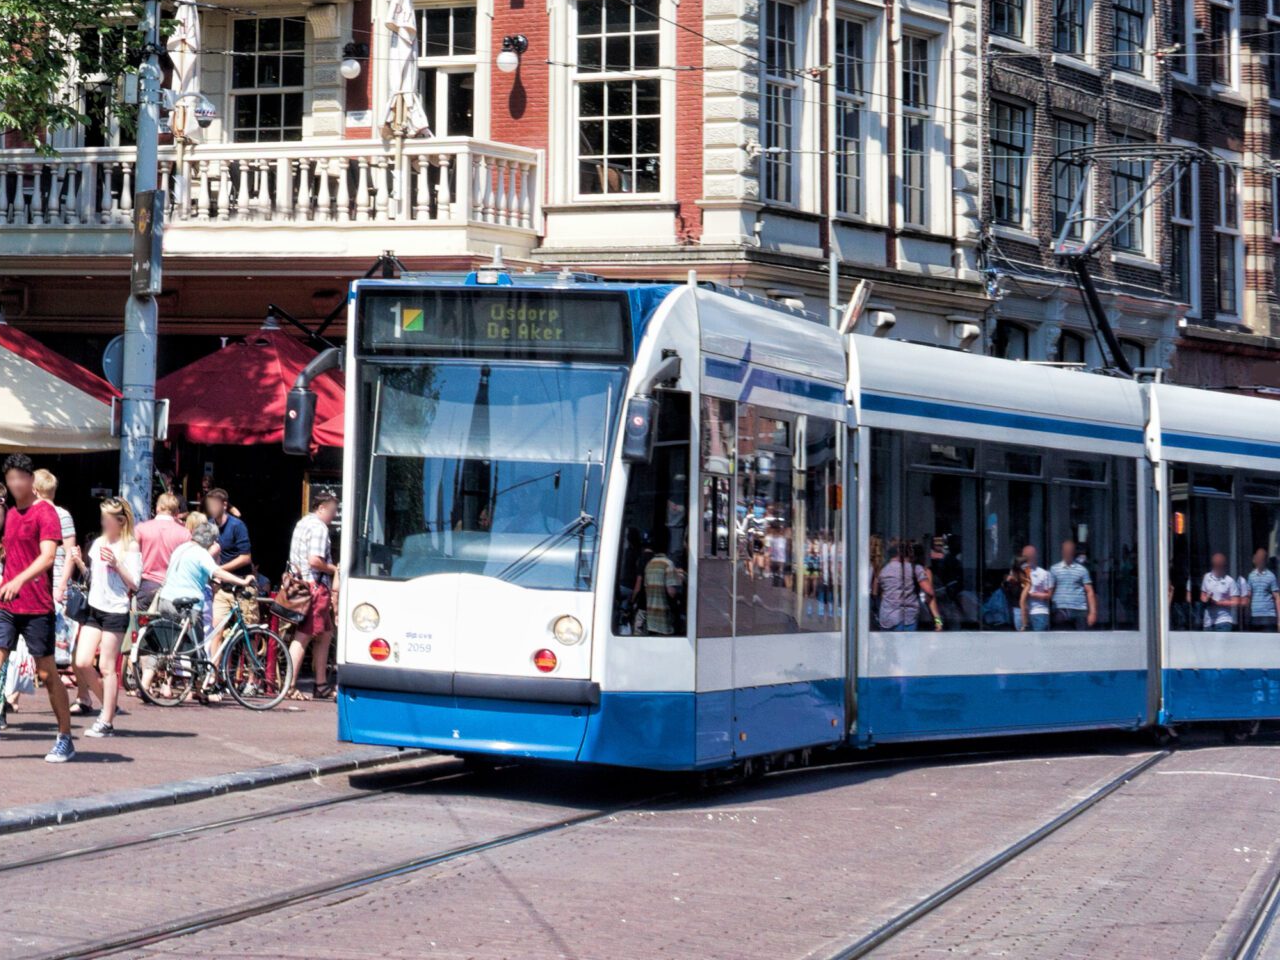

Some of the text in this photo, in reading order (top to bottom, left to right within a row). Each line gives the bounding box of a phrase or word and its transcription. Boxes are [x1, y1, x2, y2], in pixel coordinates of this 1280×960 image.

[390, 302, 402, 338] 1
[490, 303, 559, 323] Osdorp
[488, 323, 563, 340] De Aker
[408, 642, 432, 653] 2059
